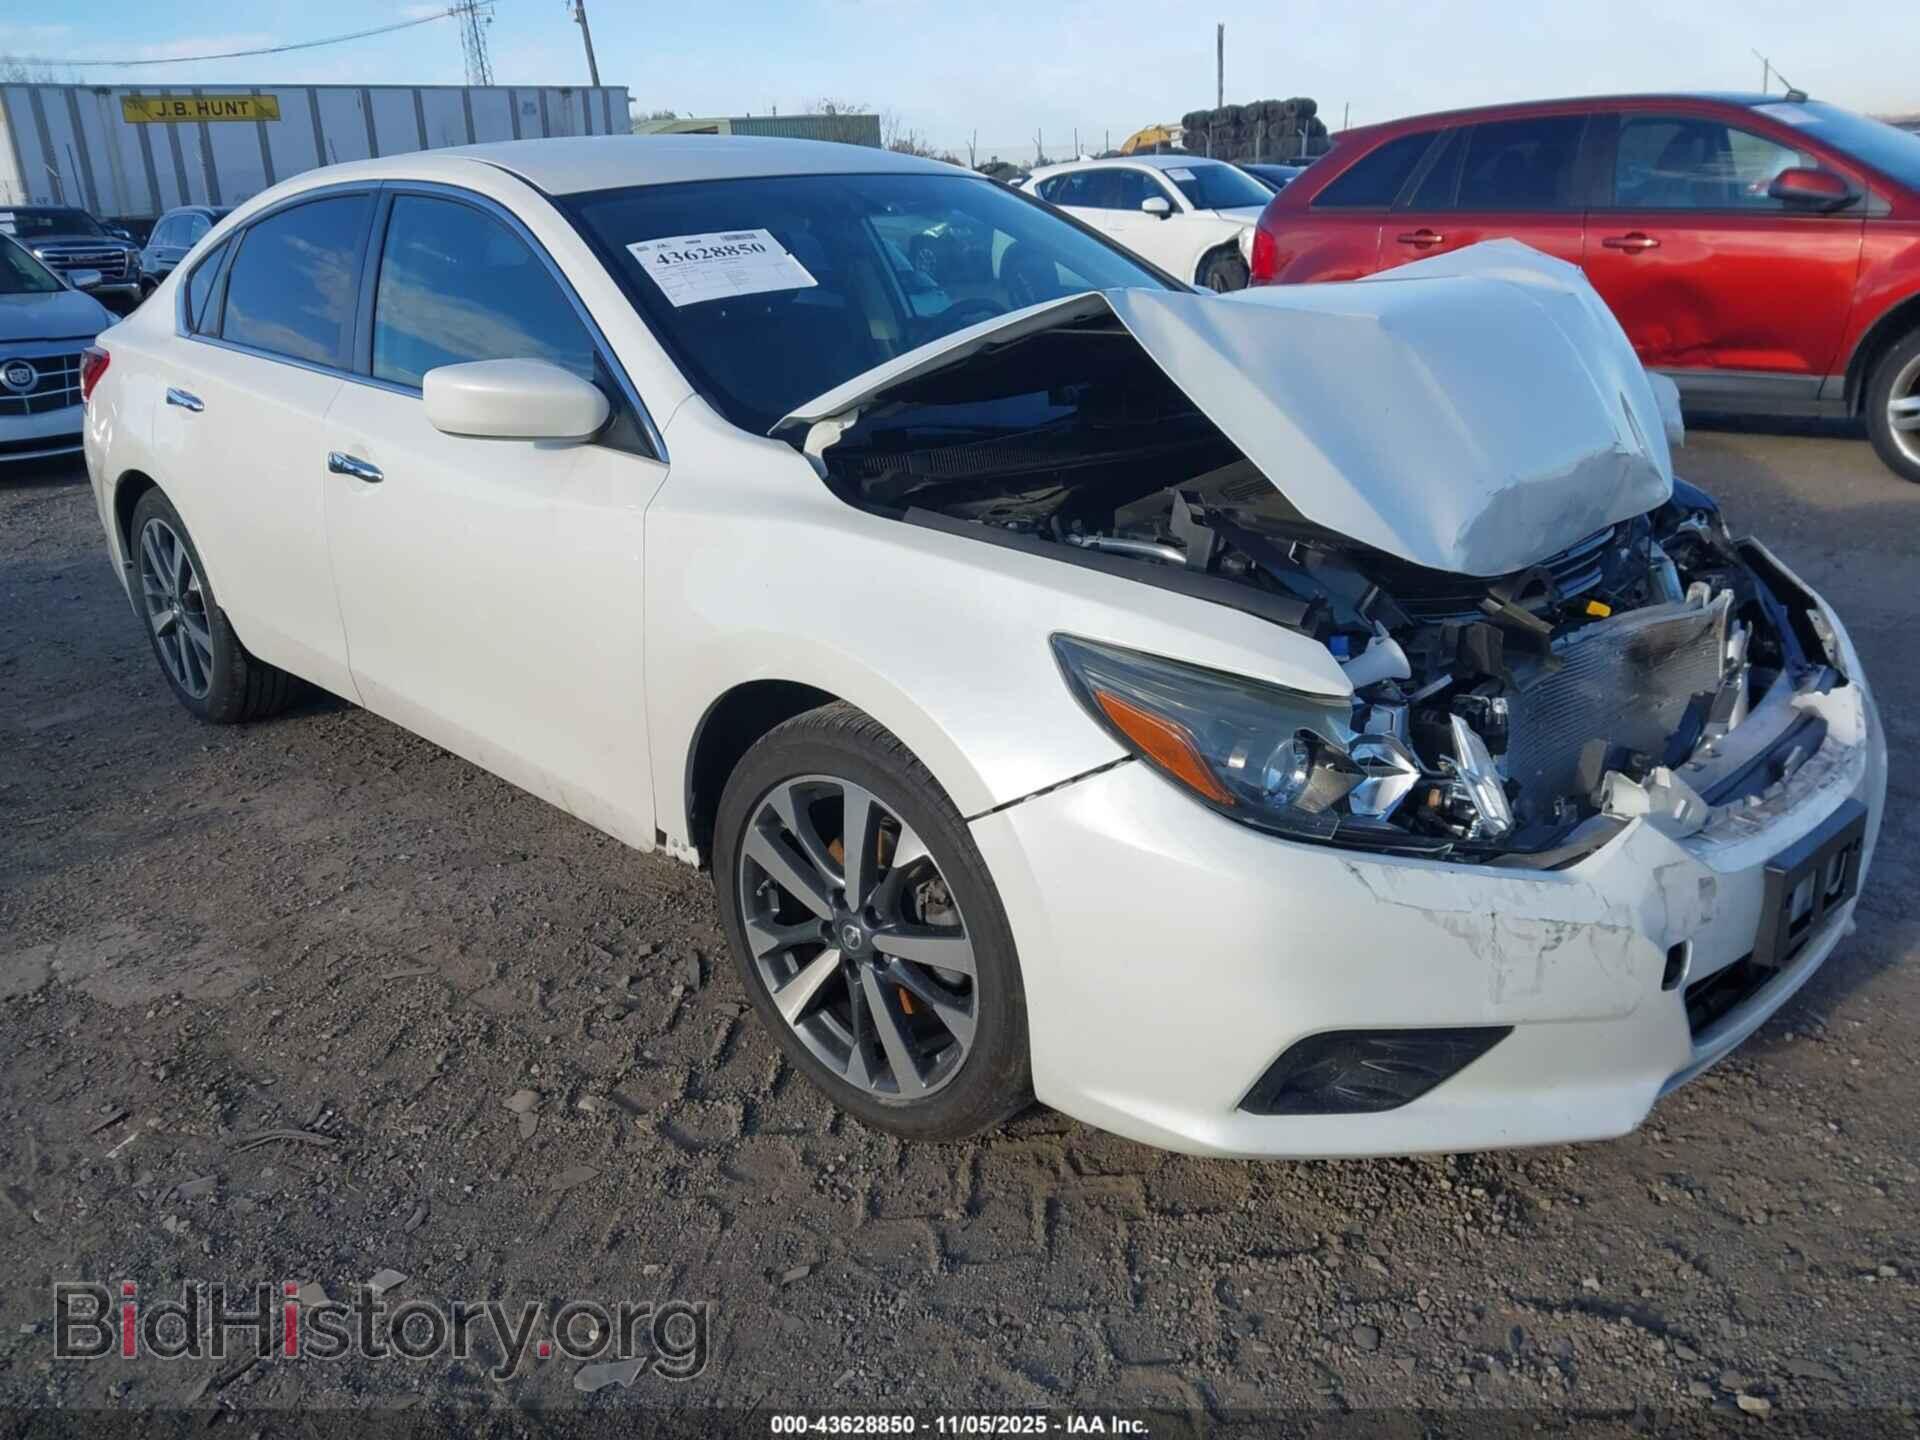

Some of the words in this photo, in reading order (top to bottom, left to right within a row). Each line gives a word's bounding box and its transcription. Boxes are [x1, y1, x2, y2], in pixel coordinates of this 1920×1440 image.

[156, 101, 192, 116] J.B.
[195, 101, 249, 116] HUNT
[656, 242, 767, 265] 43628850
